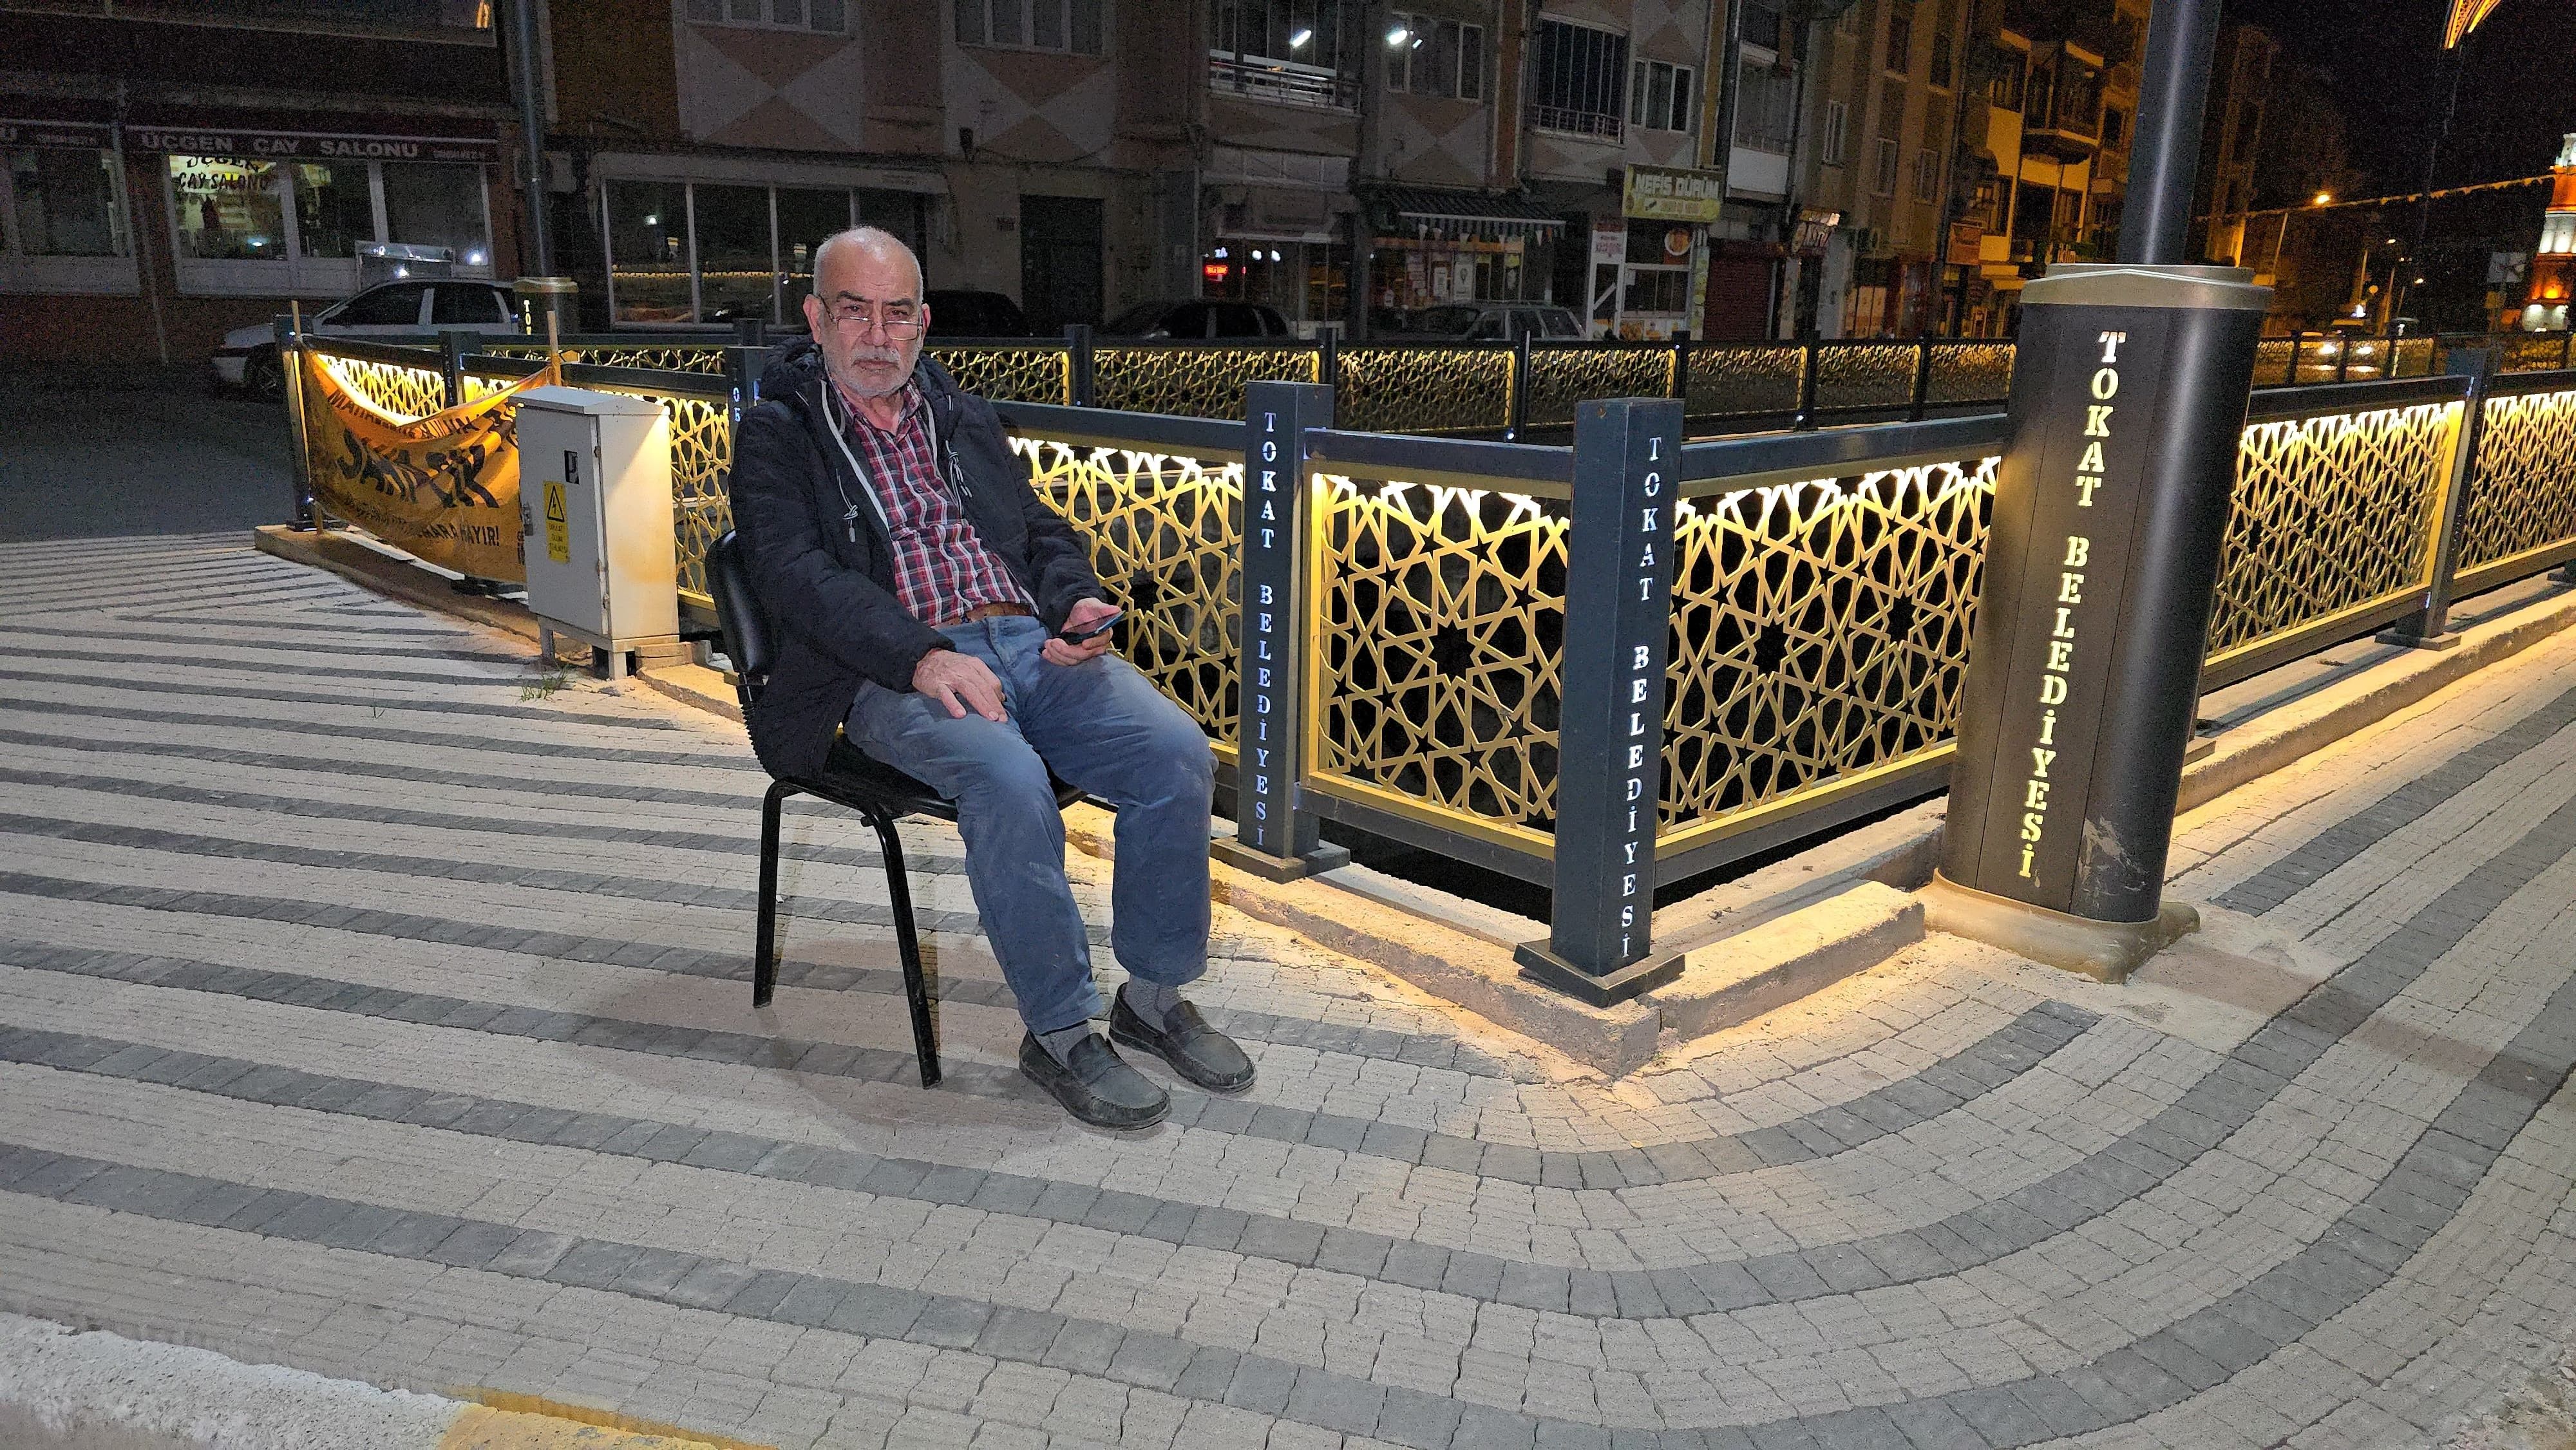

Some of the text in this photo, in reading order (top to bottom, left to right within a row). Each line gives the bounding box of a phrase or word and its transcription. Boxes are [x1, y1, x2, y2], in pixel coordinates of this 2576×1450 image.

[144, 133, 232, 152] ÜÇGEN
[254, 138, 299, 158] ÇAY
[320, 140, 419, 158] SALONU
[1636, 172, 1672, 195] NEFİS
[460, 524, 500, 546] HAYIR!
[1255, 411, 1277, 847] TOKAT BELEDİYESİ
[2018, 331, 2125, 878] TOKAT BELEDİYESİ
[1622, 437, 1663, 958] TOKAT BELEDİYESİ
